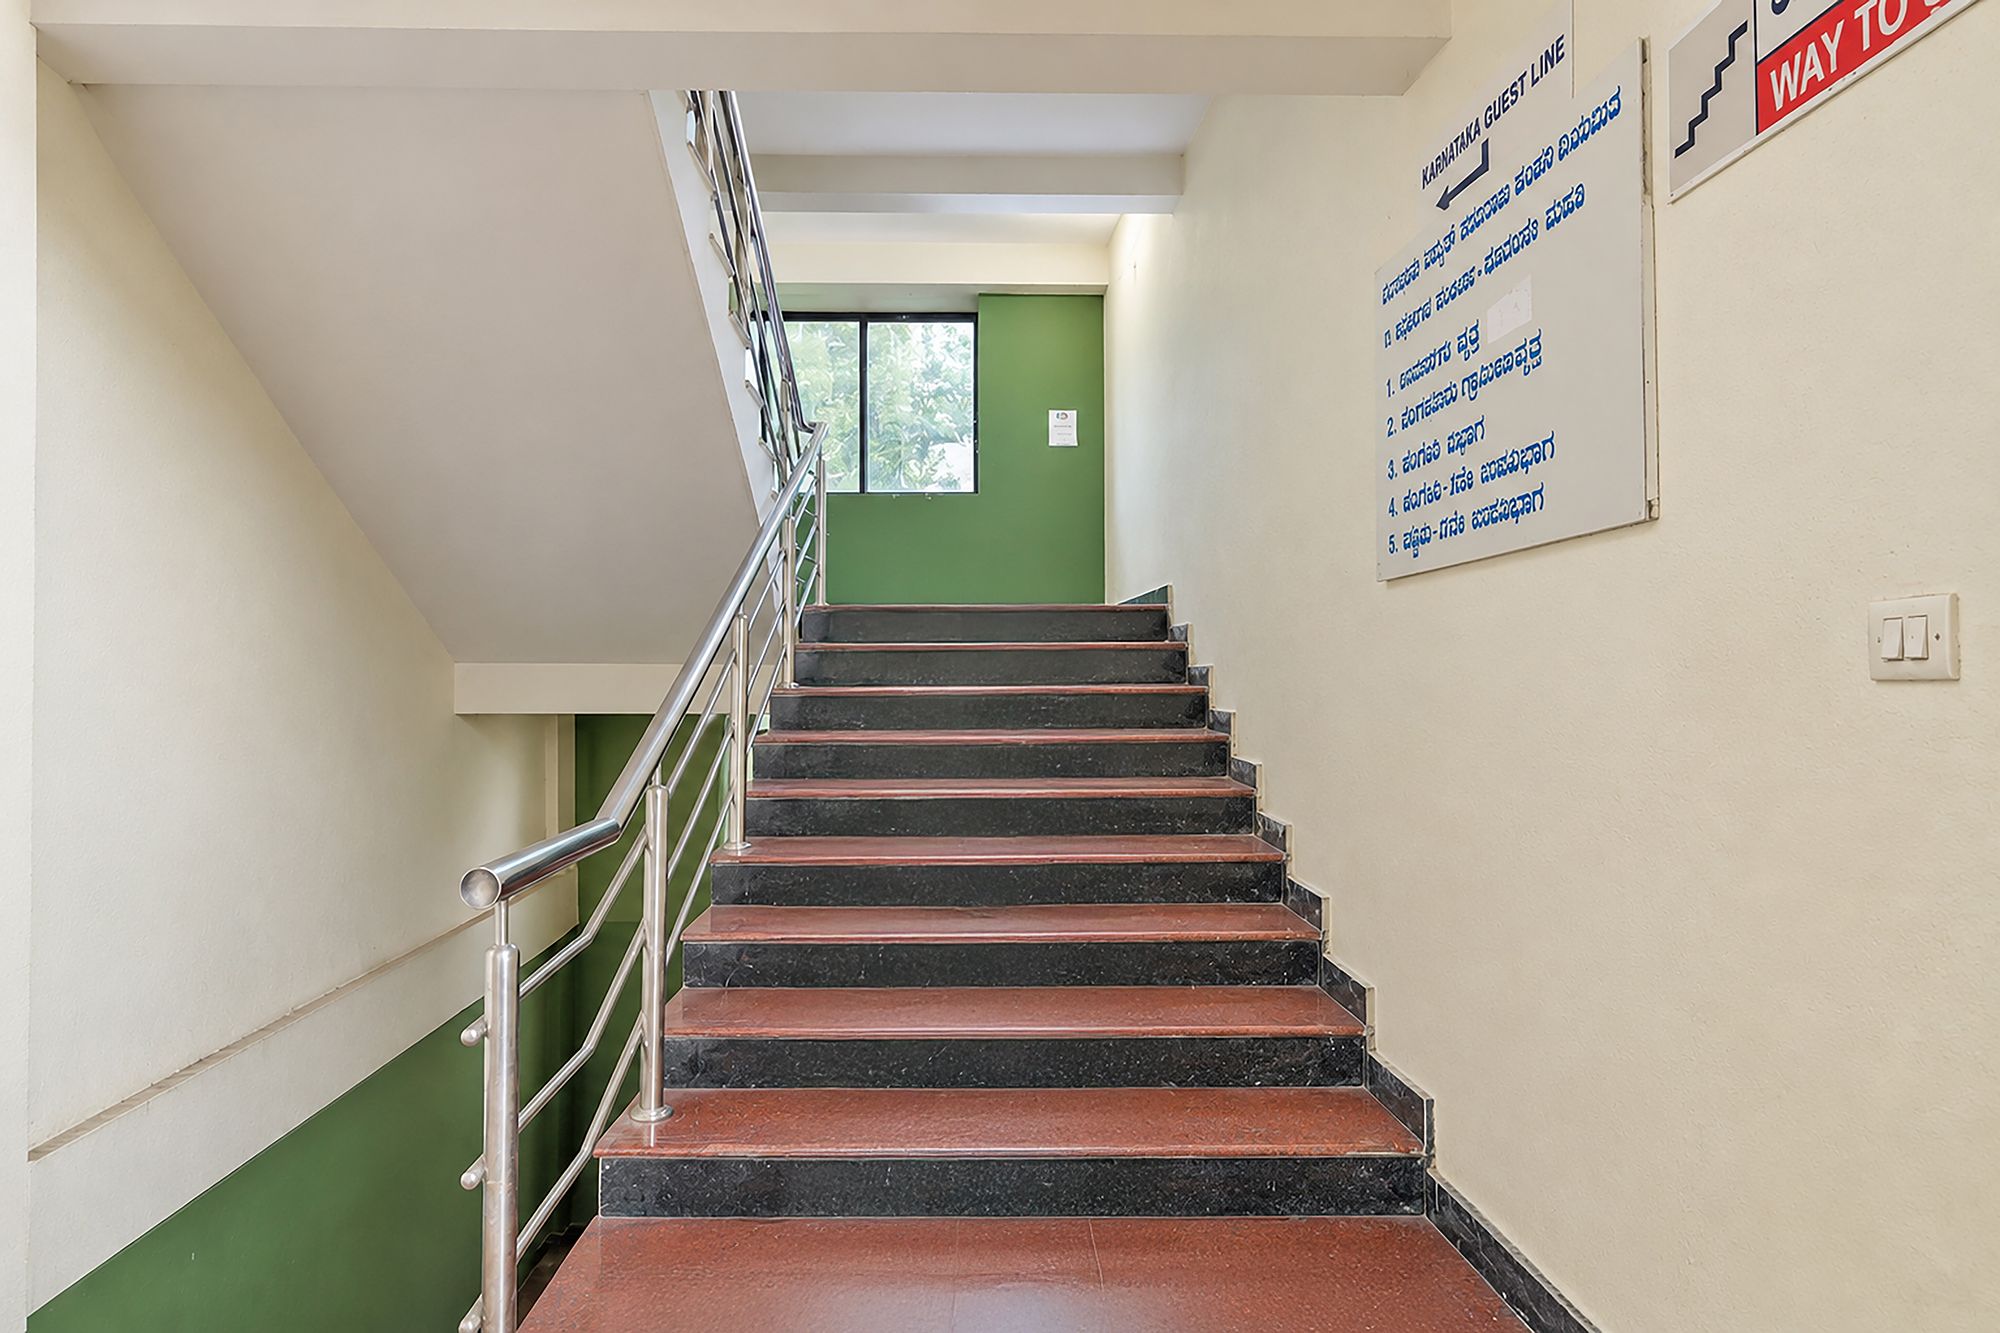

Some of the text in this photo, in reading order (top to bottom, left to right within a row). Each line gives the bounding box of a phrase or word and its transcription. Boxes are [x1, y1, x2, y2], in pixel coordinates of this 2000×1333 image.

[1423, 34, 1564, 189] KARNATAKA GUEST LINE
[1770, 0, 1907, 111] WAY TO
